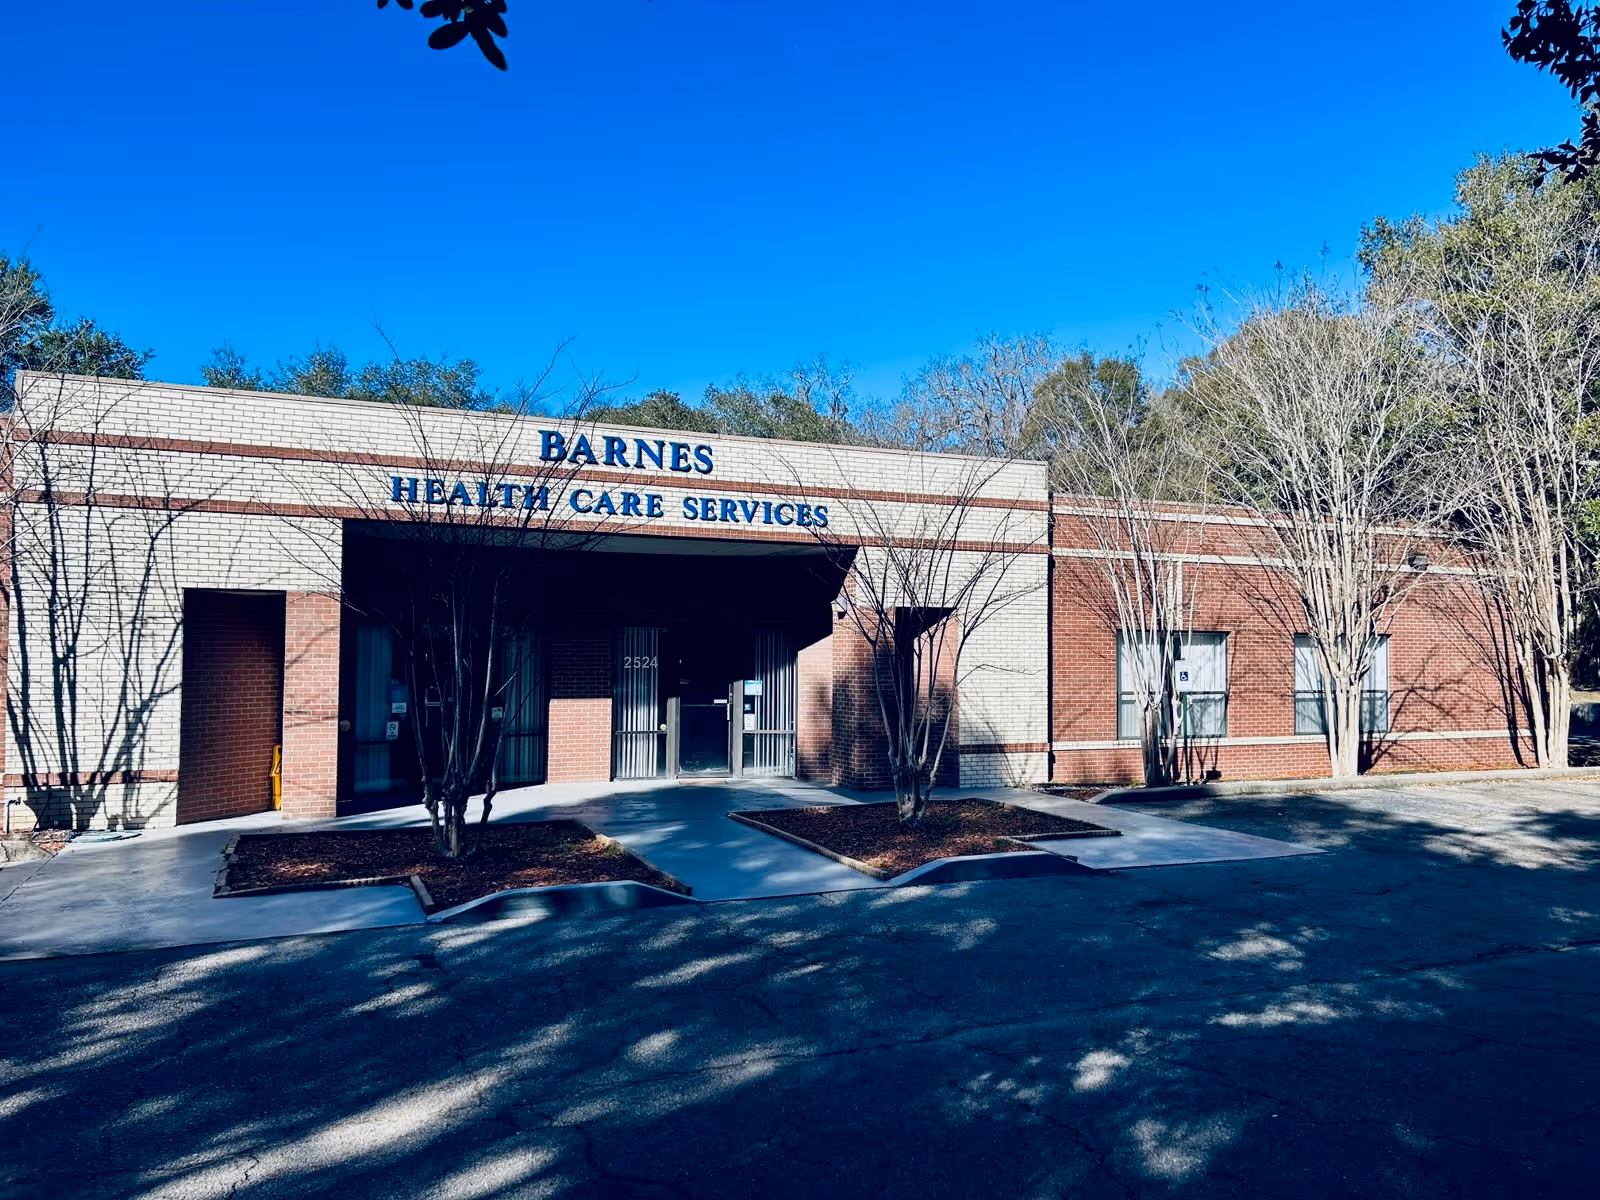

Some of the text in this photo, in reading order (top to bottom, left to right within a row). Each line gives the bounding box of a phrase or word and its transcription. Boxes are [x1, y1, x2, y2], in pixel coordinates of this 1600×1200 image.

[538, 430, 714, 475] BARNES
[391, 476, 829, 528] HEALTH CARE SERVICES
[624, 656, 659, 669] 2524
